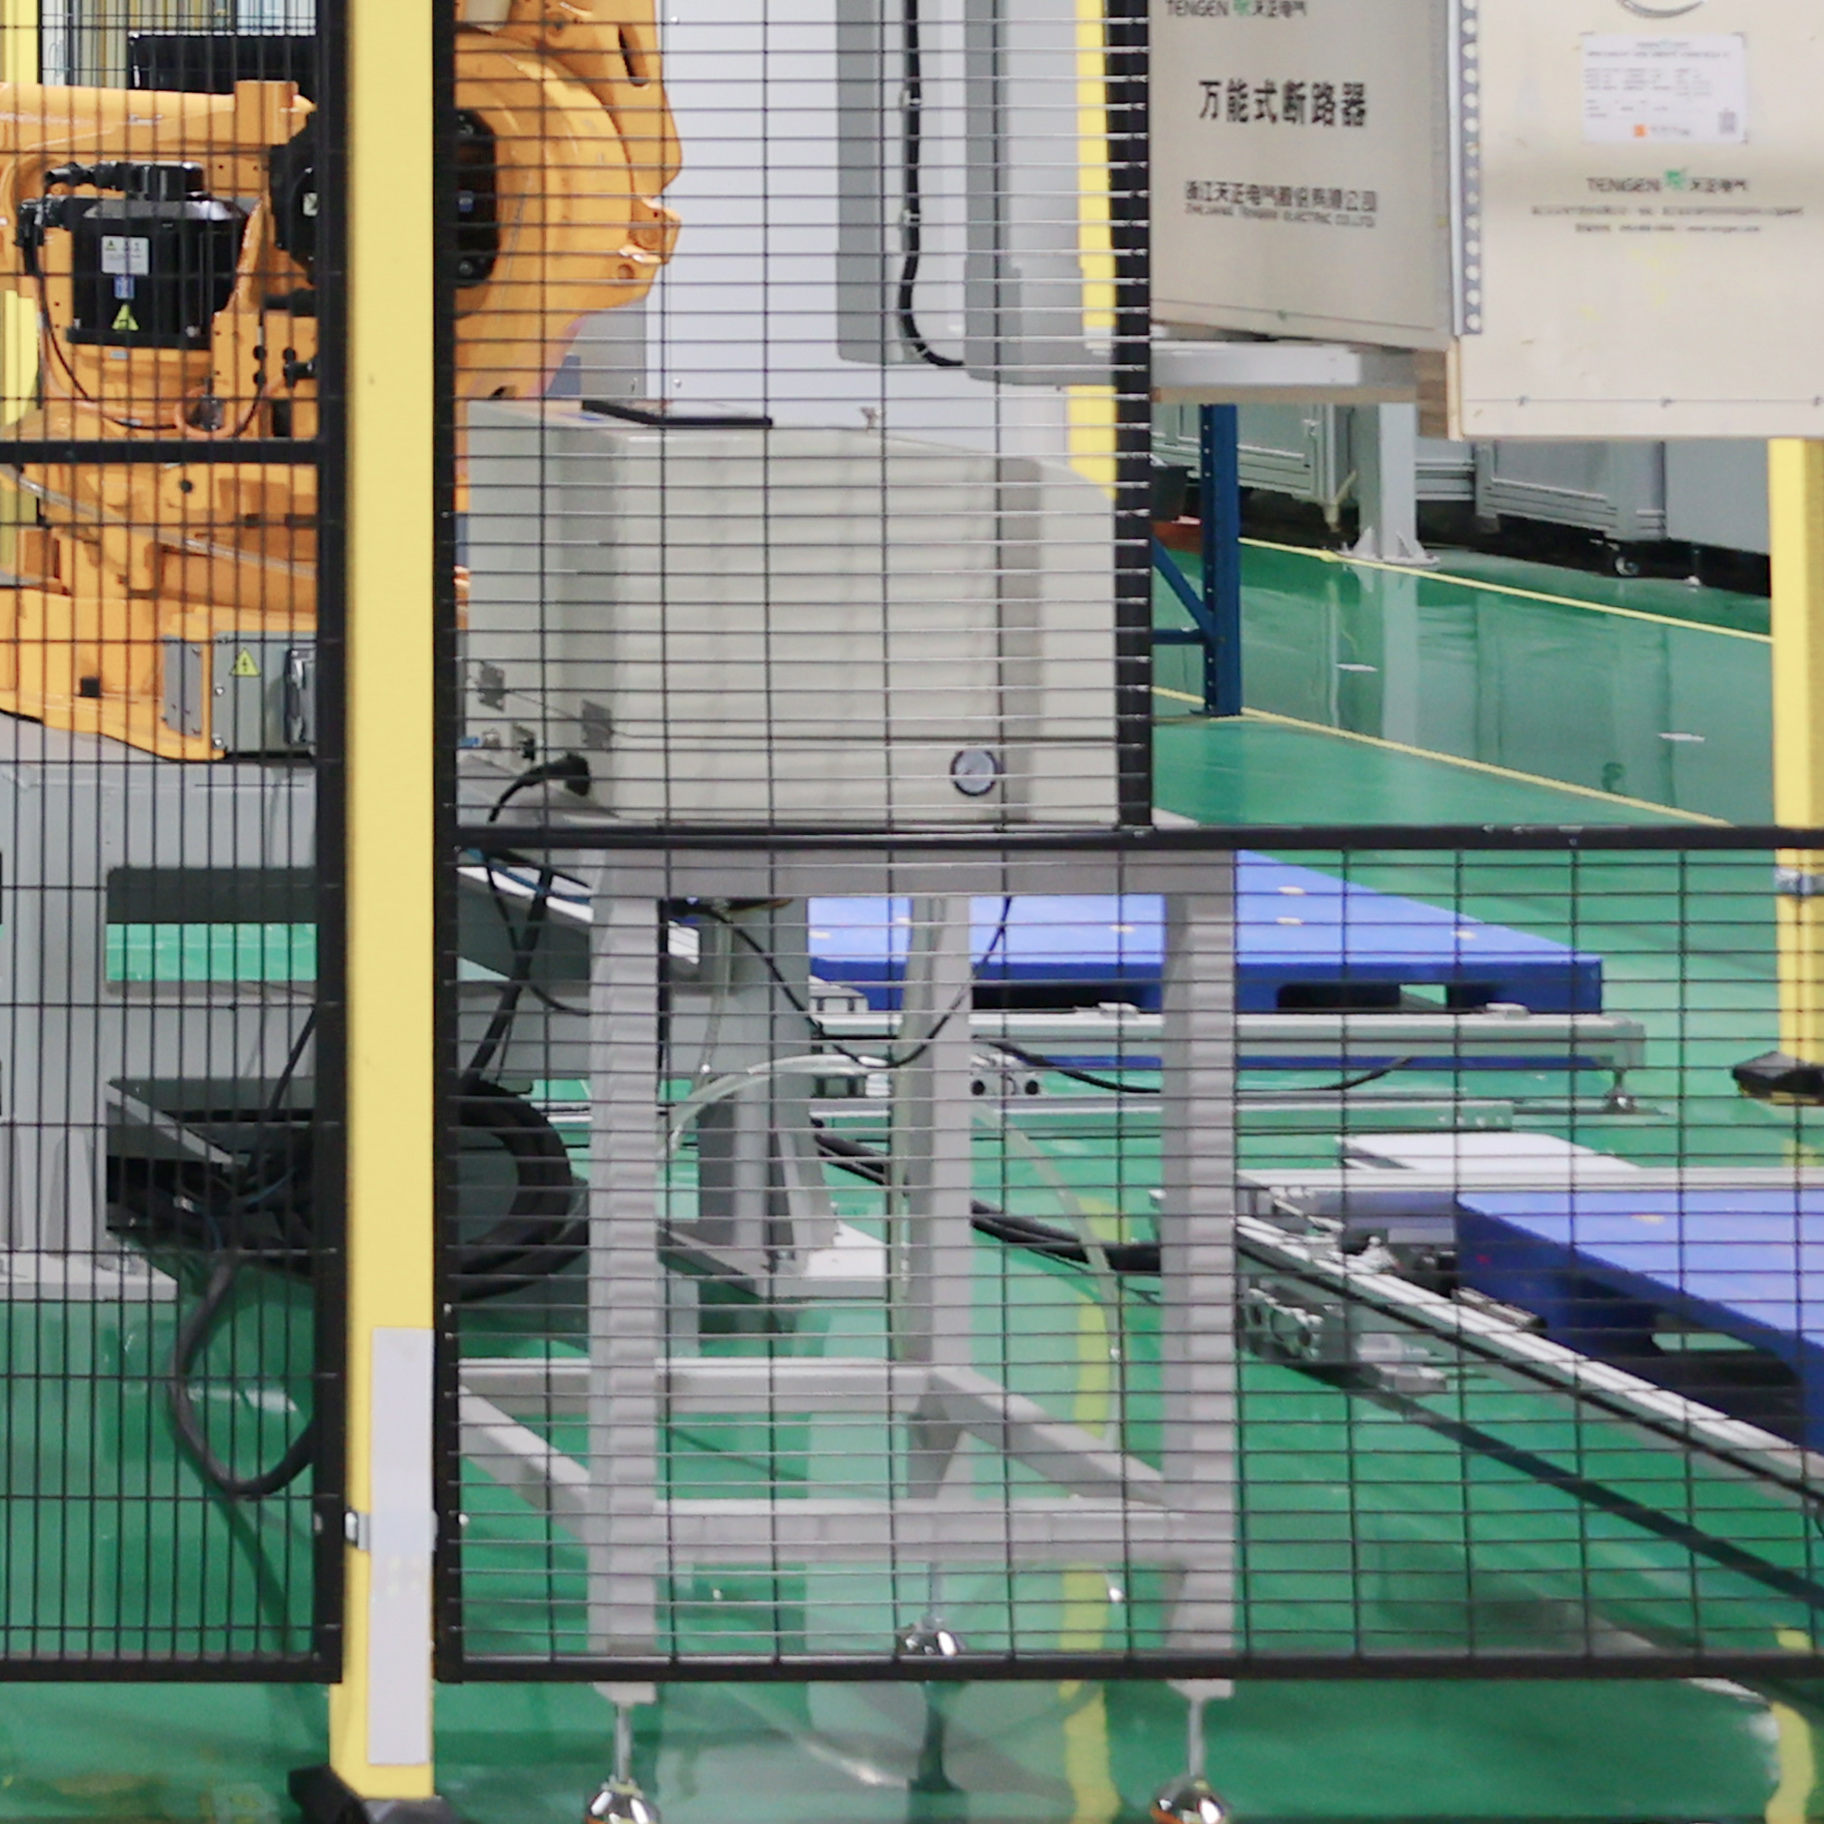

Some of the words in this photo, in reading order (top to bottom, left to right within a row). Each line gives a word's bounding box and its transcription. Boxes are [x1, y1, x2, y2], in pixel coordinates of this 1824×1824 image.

[1166, 0, 1229, 17] TENGEN
[1199, 79, 1366, 127] 万能式断路器
[1586, 177, 1662, 193] TENGEN
